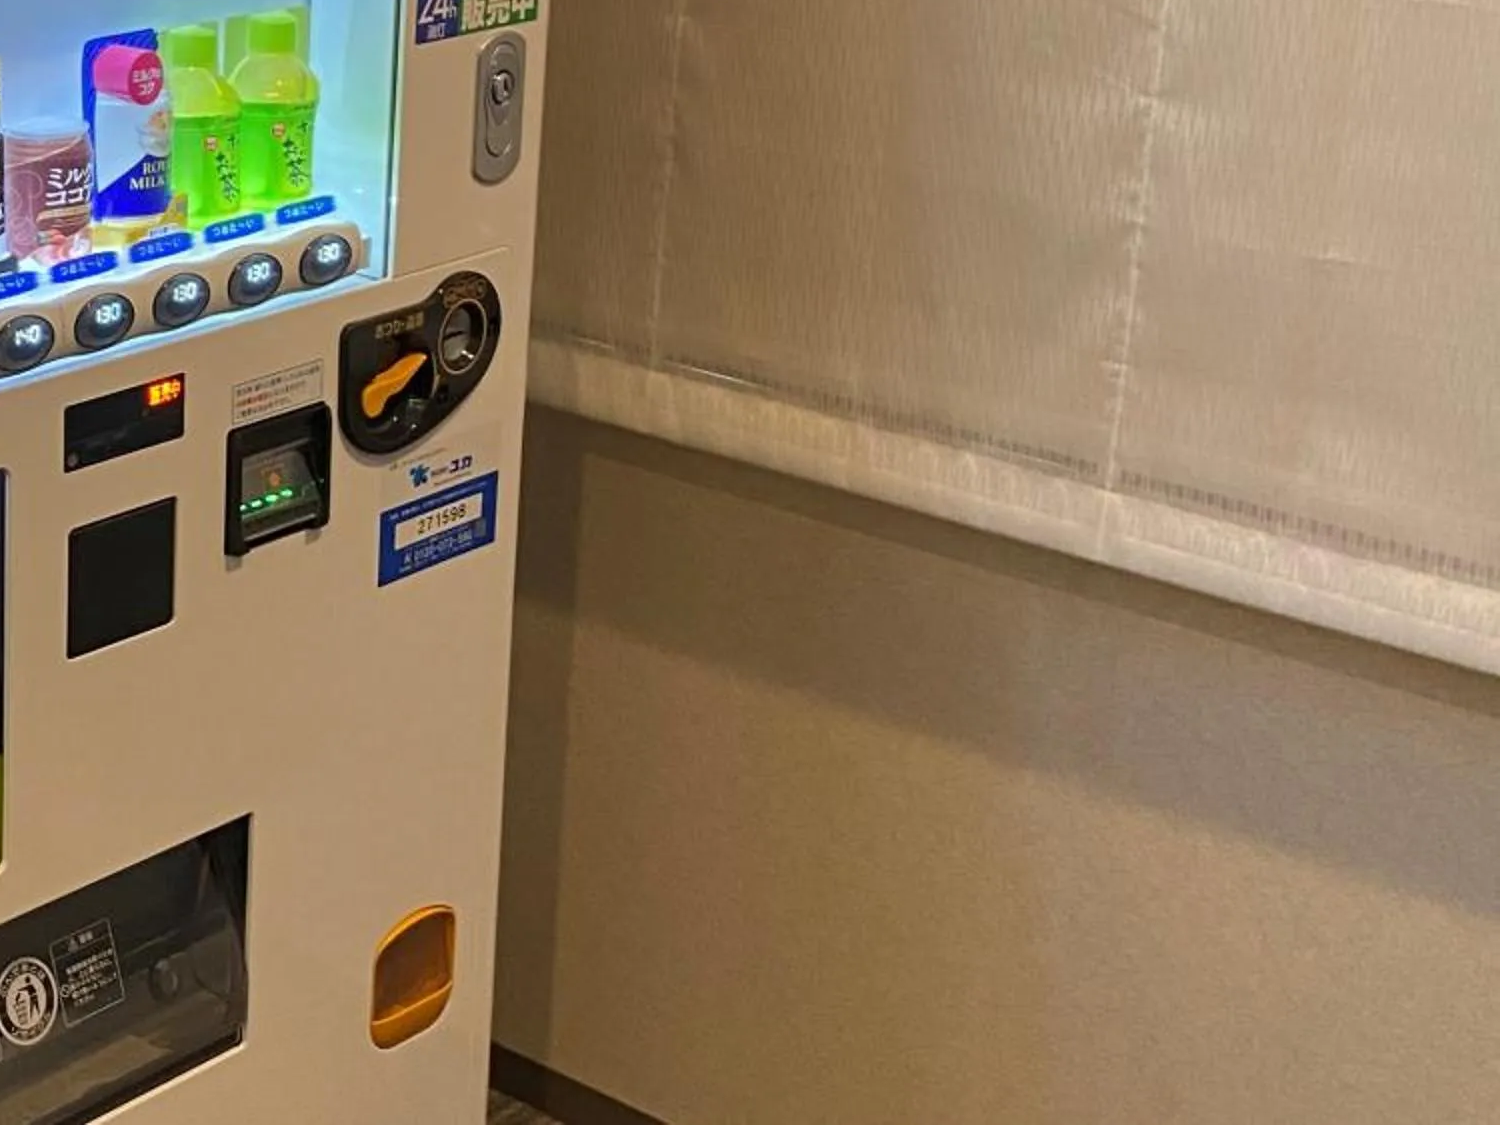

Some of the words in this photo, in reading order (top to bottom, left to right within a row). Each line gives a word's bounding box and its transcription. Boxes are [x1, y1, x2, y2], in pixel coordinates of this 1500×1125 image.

[14, 325, 41, 347] 140
[95, 302, 122, 325] 130
[172, 282, 197, 302] 130
[246, 262, 270, 283] 130
[316, 242, 340, 263] 130
[416, 503, 467, 536] 271598
